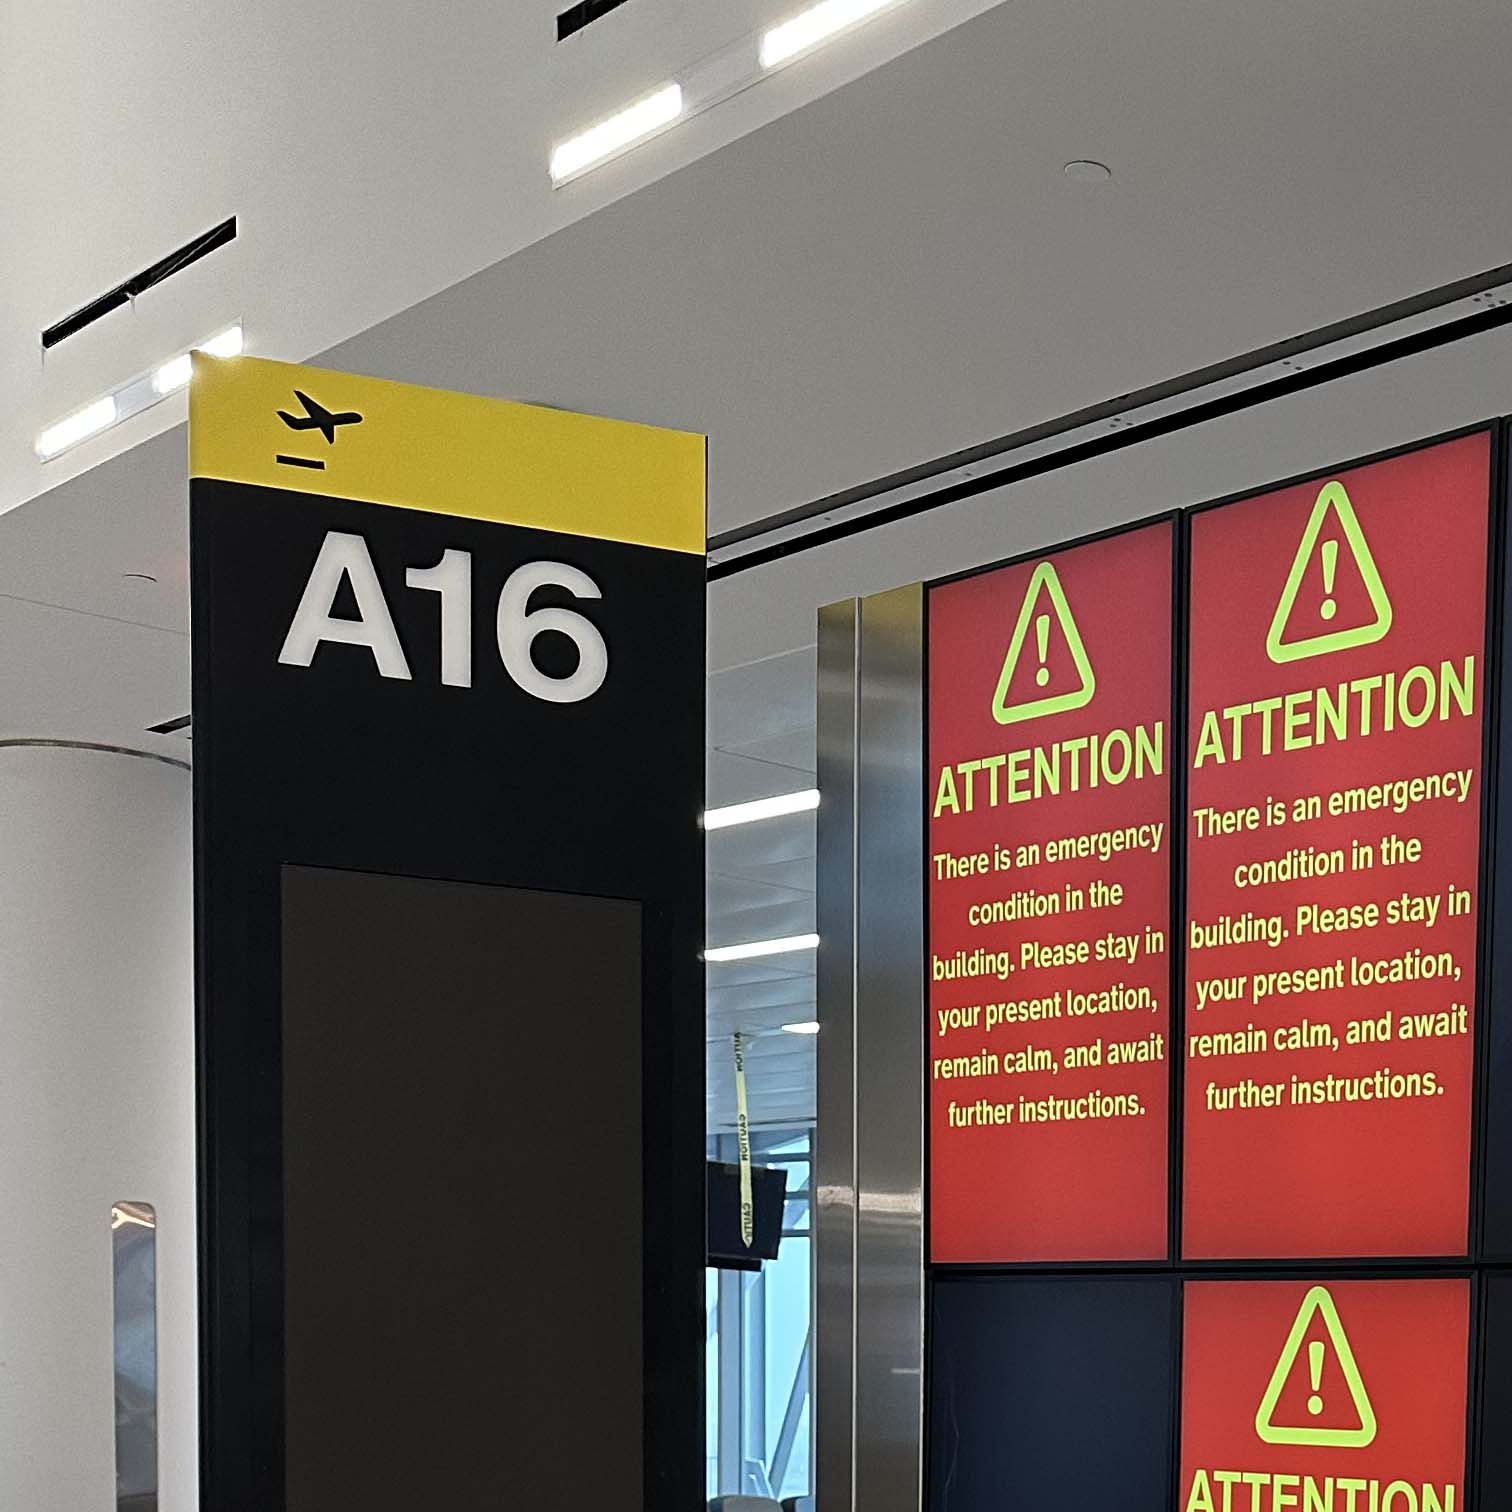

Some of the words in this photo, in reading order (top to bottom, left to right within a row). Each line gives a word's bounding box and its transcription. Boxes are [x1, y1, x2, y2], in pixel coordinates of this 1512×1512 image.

[276, 530, 610, 705] A16
[1193, 655, 1475, 769] ATTENTION
[933, 721, 1163, 818] ATTENTION
[1192, 806, 1260, 837] There
[1266, 798, 1287, 826] is
[1292, 795, 1322, 823] an
[1328, 769, 1473, 817] emergency
[933, 852, 990, 881] There
[994, 848, 1011, 871] is
[1015, 844, 1040, 868] an
[1045, 824, 1163, 863] emergency
[1234, 848, 1345, 888] condition
[1351, 840, 1373, 871] in
[1379, 834, 1422, 866] the
[968, 890, 1060, 926] condition
[1065, 885, 1084, 912] in
[1088, 880, 1124, 909] the
[1190, 912, 1289, 949] building.
[1296, 903, 1380, 936] Please
[1386, 893, 1441, 928] stay
[1448, 885, 1471, 916] in
[933, 949, 1015, 981] building.
[1020, 941, 1090, 970] Please
[1095, 932, 1140, 964] stay
[1145, 927, 1164, 955] in
[1195, 976, 1247, 1010] your
[1253, 959, 1345, 1005] present
[1350, 948, 1461, 987] location,
[938, 1005, 981, 1037] your
[985, 991, 1062, 1032] present
[1066, 983, 1158, 1017] location,
[1189, 1023, 1267, 1058] remain
[1273, 1019, 1339, 1051] calm,
[1345, 1011, 1392, 1045] and
[1398, 1003, 1468, 1040] await
[933, 1049, 999, 1080] remain
[1003, 1045, 1059, 1074] calm,
[1063, 1039, 1102, 1069] and
[1106, 1033, 1164, 1065] await
[947, 1100, 1015, 1128] further
[1019, 1090, 1145, 1123] instructions.
[1205, 1079, 1285, 1110] further
[1291, 1067, 1444, 1105] instructions.
